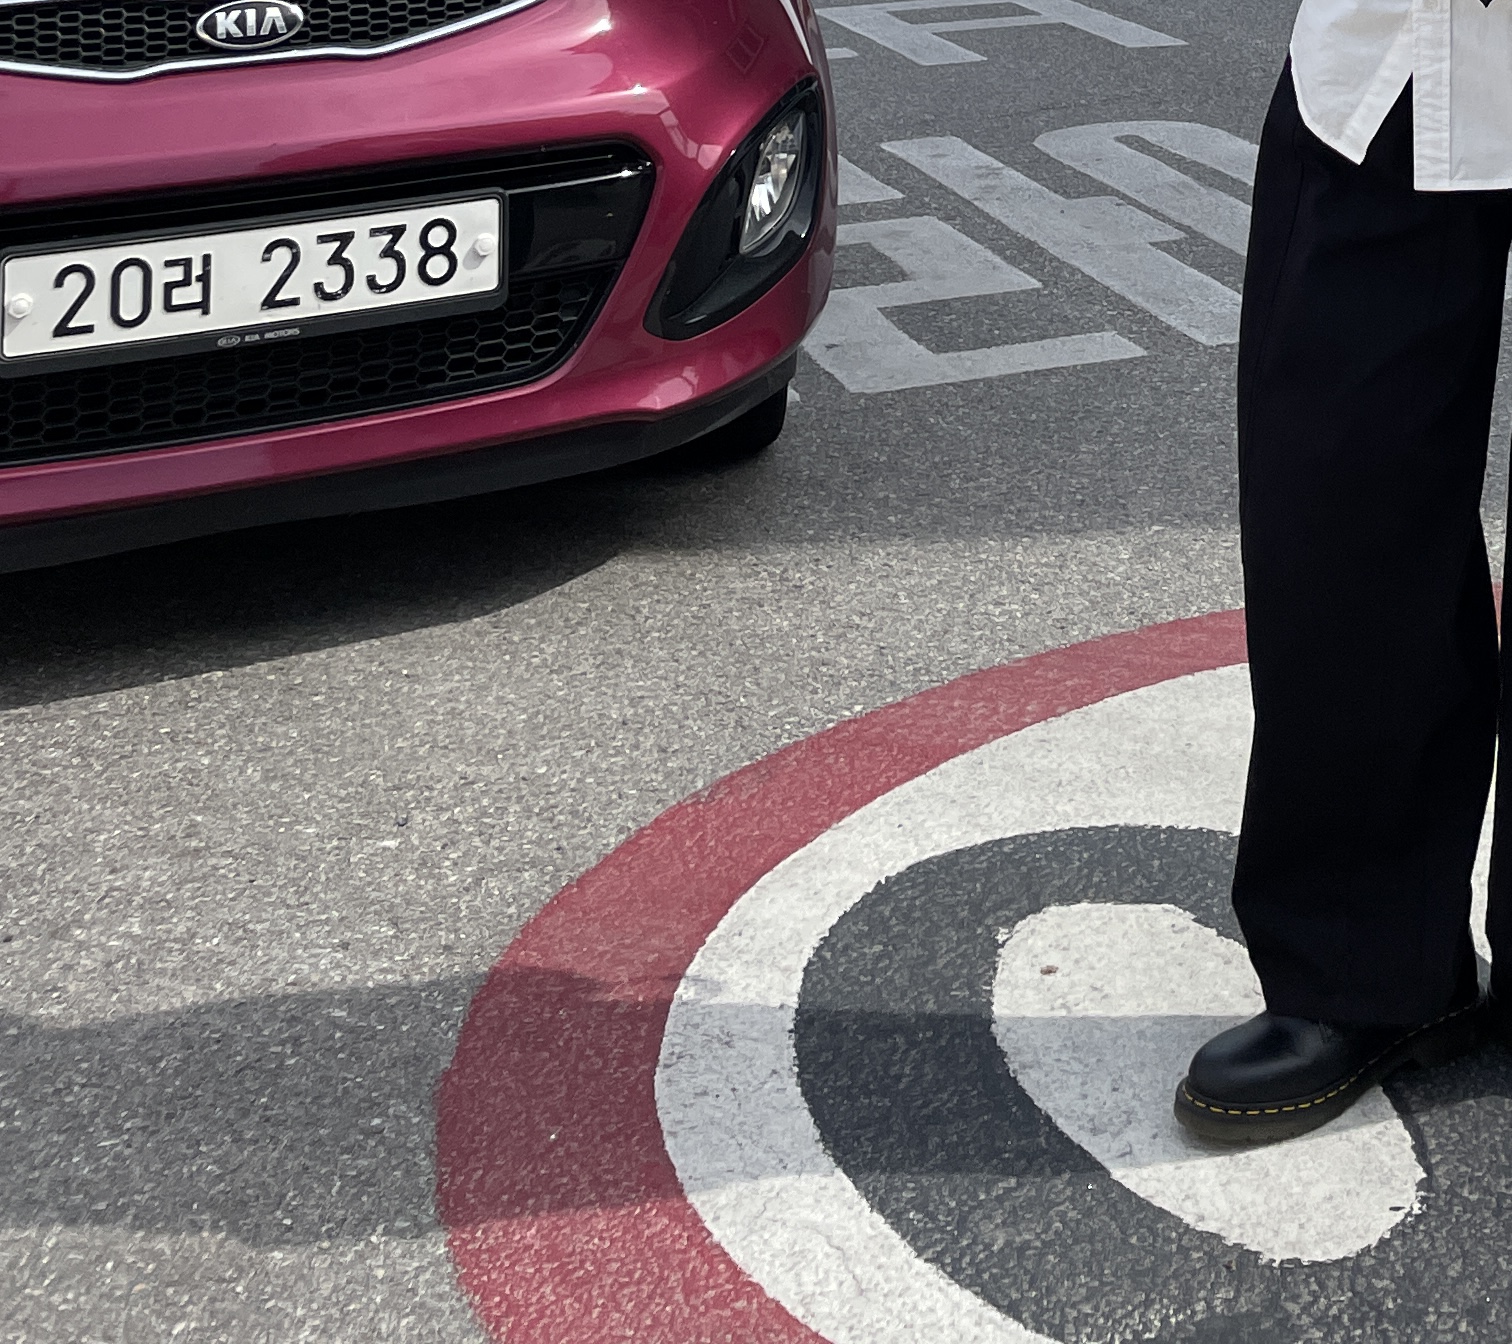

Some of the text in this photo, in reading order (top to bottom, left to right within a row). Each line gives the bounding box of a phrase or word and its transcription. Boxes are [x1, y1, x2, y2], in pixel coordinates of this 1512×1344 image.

[215, 6, 287, 39] KIA
[52, 216, 459, 339] 20러 2338
